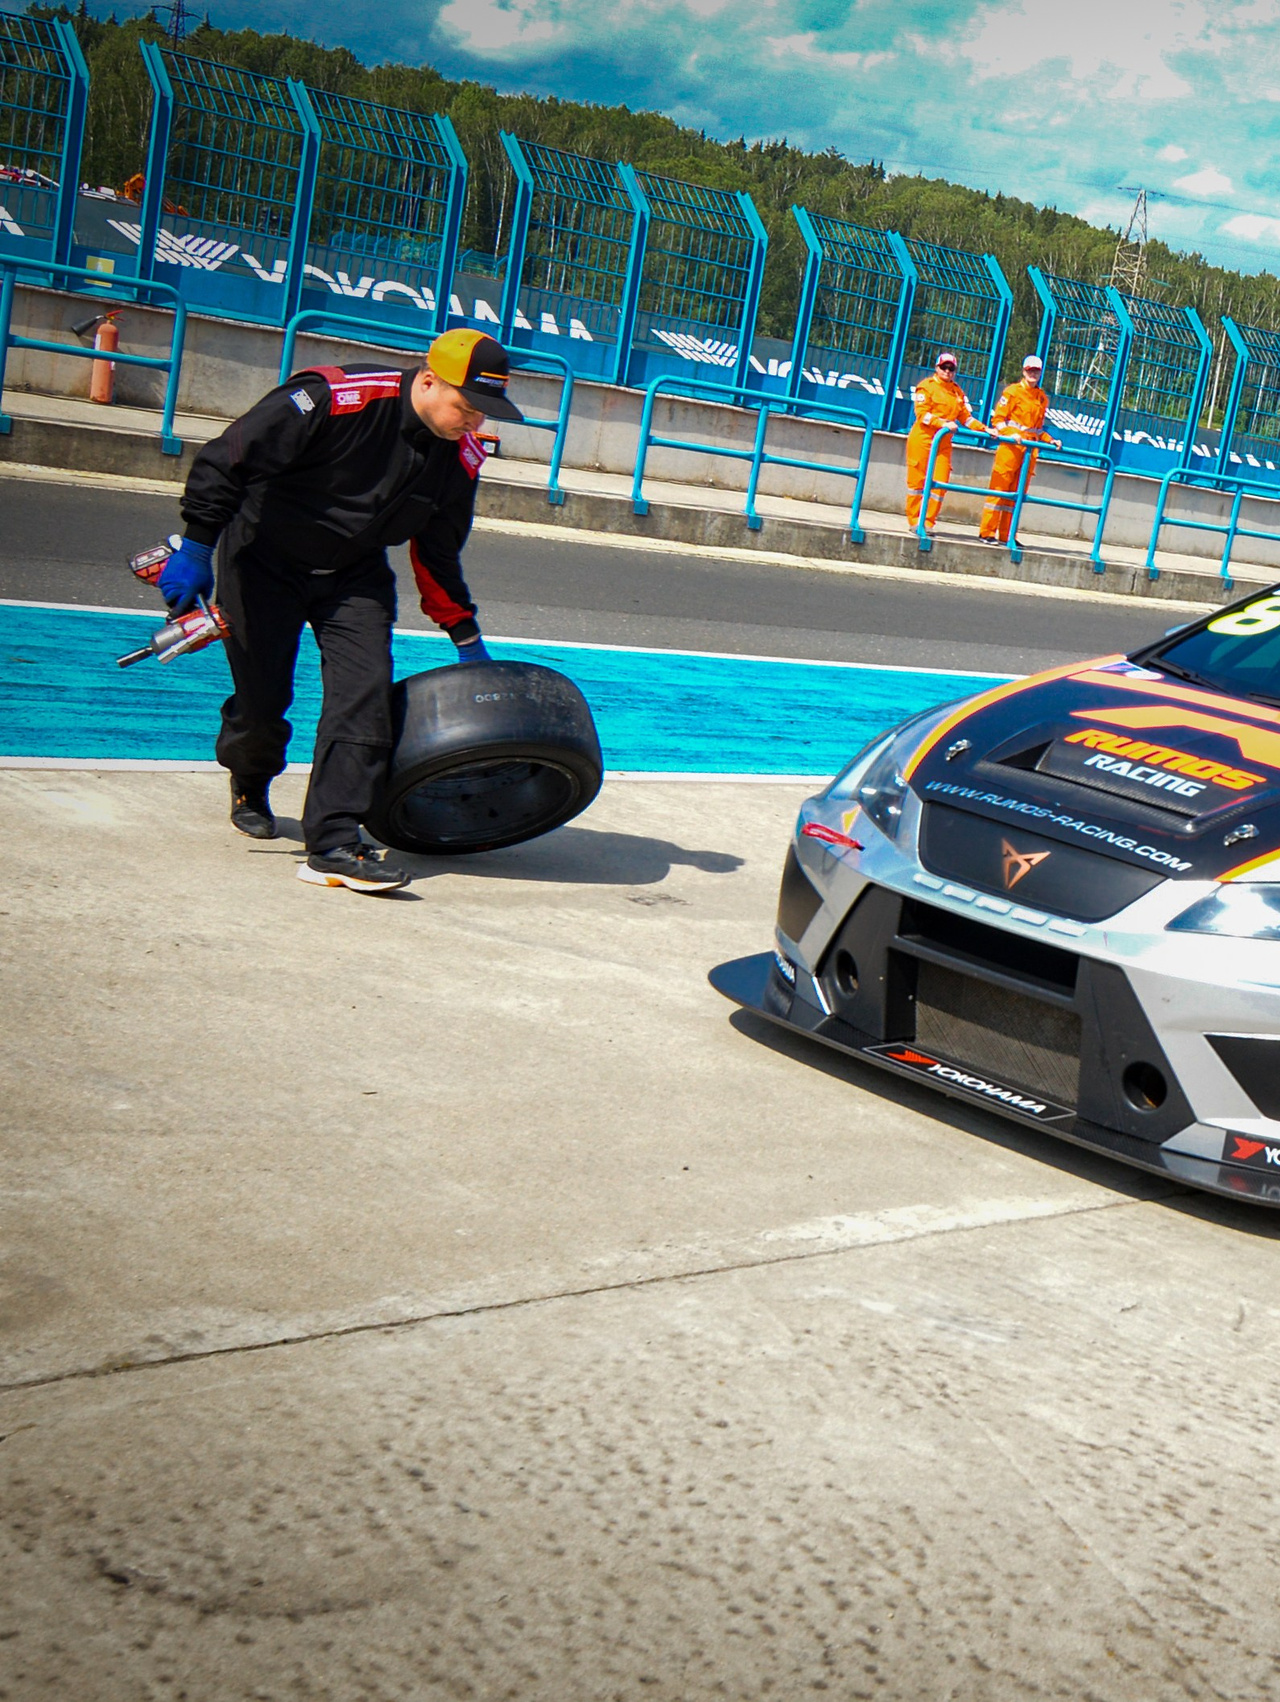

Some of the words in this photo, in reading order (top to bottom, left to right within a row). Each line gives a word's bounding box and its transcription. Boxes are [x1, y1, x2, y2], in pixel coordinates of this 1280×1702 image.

[1064, 728, 1267, 791] RUMOS
[1083, 753, 1208, 798] RACING
[924, 780, 1193, 872] WWW.RUMOS-RACING.COM
[927, 1063, 1047, 1114] YOKOHAMA
